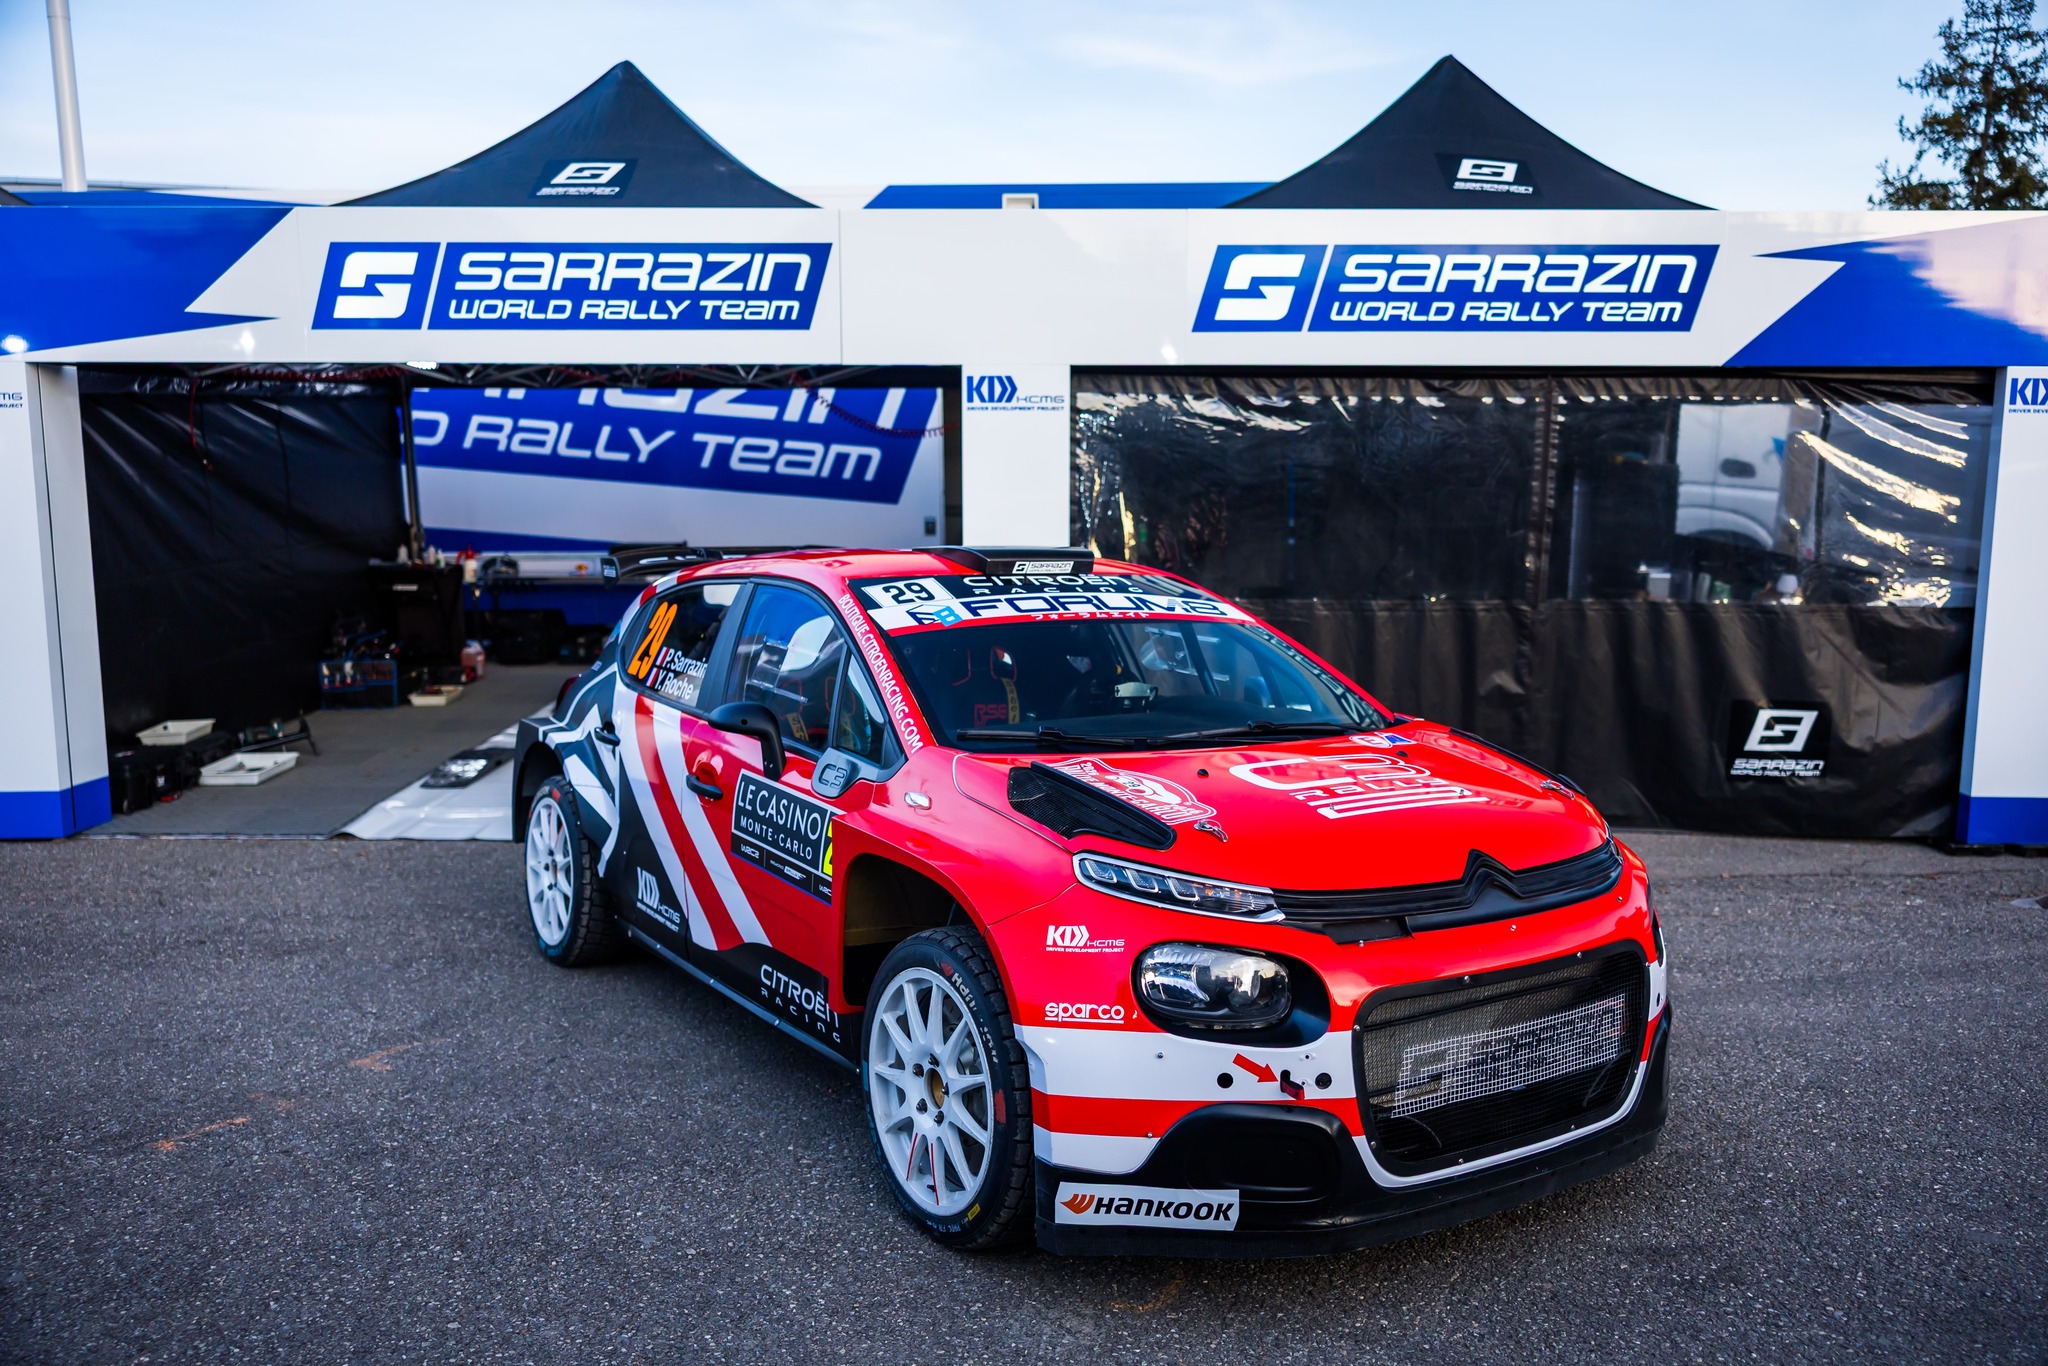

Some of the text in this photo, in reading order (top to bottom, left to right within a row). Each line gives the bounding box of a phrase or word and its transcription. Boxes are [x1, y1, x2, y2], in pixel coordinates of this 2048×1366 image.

[454, 251, 812, 291] SARRAZIN
[1338, 254, 1698, 293] SARRAZIN
[448, 299, 573, 320] WORLD
[579, 299, 692, 320] RALLY
[1329, 301, 1454, 322] WORLD
[1460, 301, 1574, 322] RALLY
[462, 413, 677, 463] RALLY
[882, 582, 936, 605] 29
[972, 586, 1144, 595] RACING
[958, 595, 1228, 618] FORUM8
[627, 601, 678, 680] 29
[839, 594, 924, 754] BOUTIQUE.CITROENRACING.COM
[738, 781, 822, 841] LE CASINO
[1044, 1001, 1126, 1023] sparco
